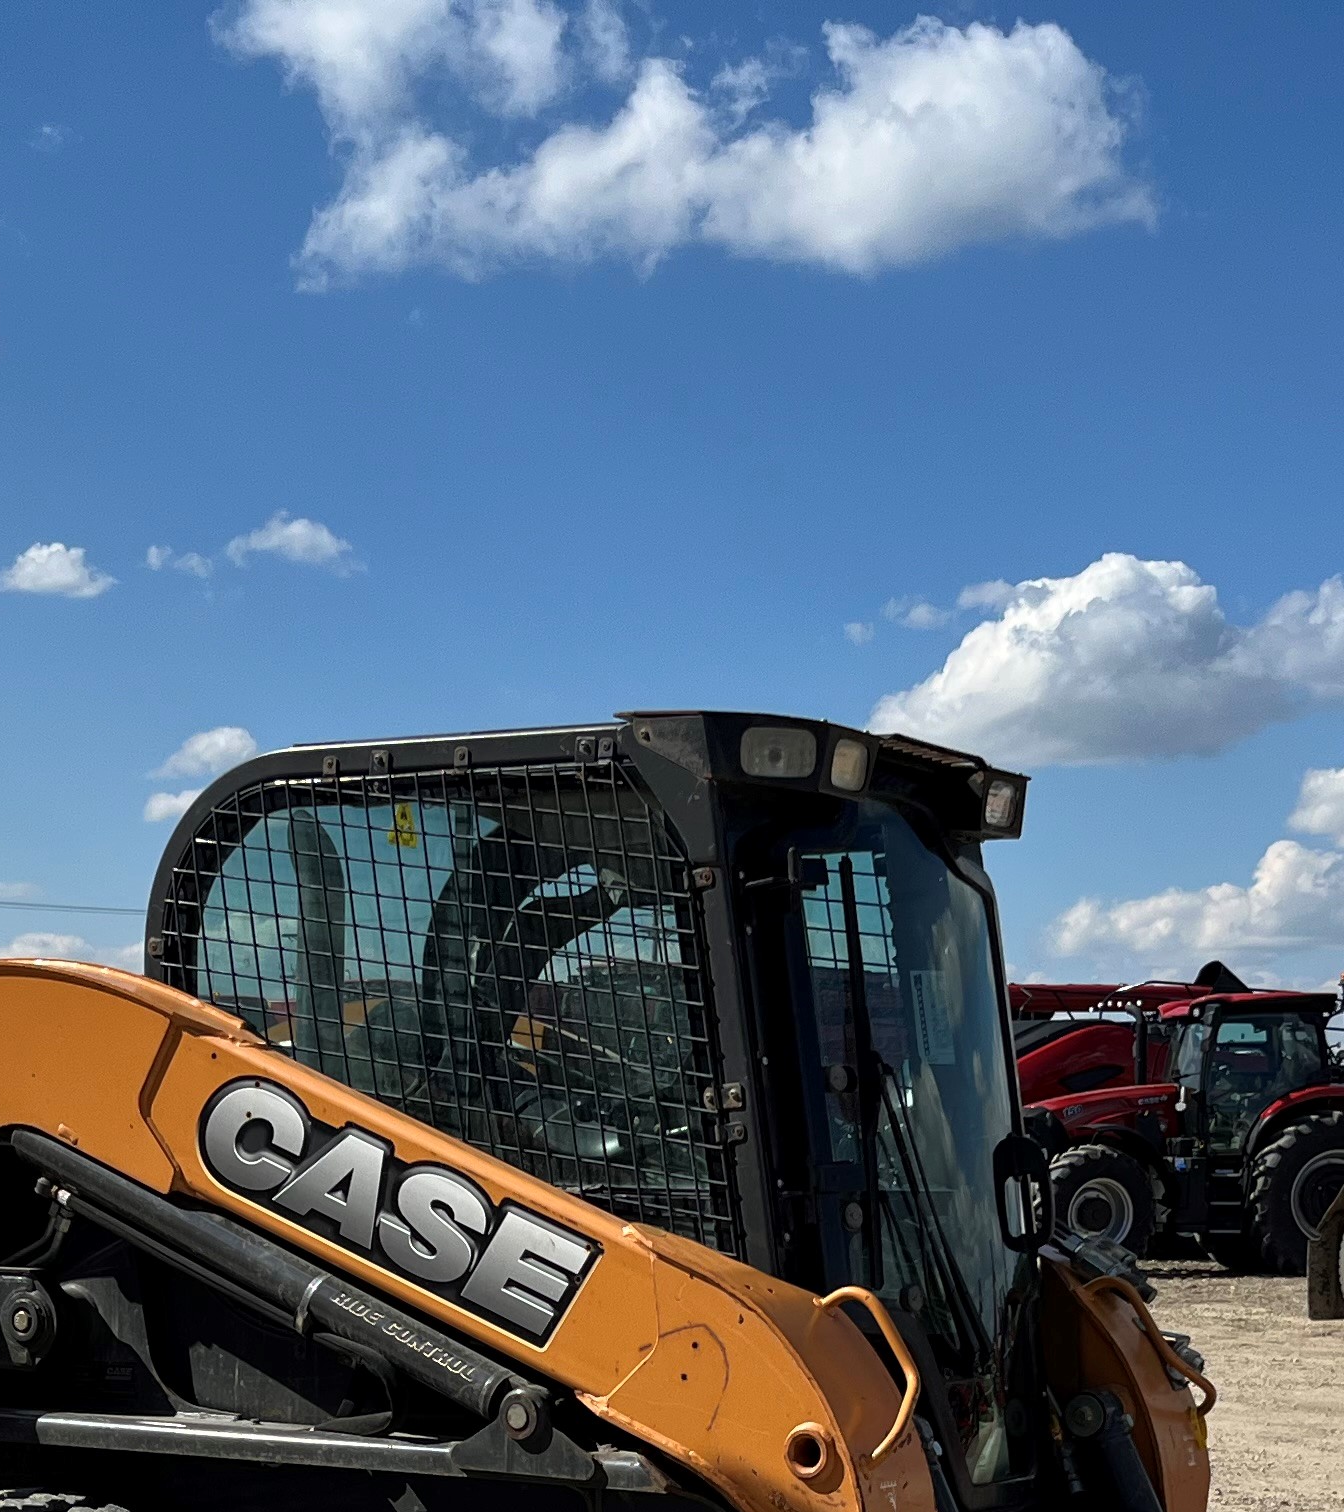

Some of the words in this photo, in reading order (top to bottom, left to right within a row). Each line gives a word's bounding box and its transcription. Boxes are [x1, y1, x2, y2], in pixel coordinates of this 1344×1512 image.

[202, 1082, 596, 1338] CASE
[329, 1291, 385, 1326] RIDE
[381, 1320, 476, 1382] CONTROL
